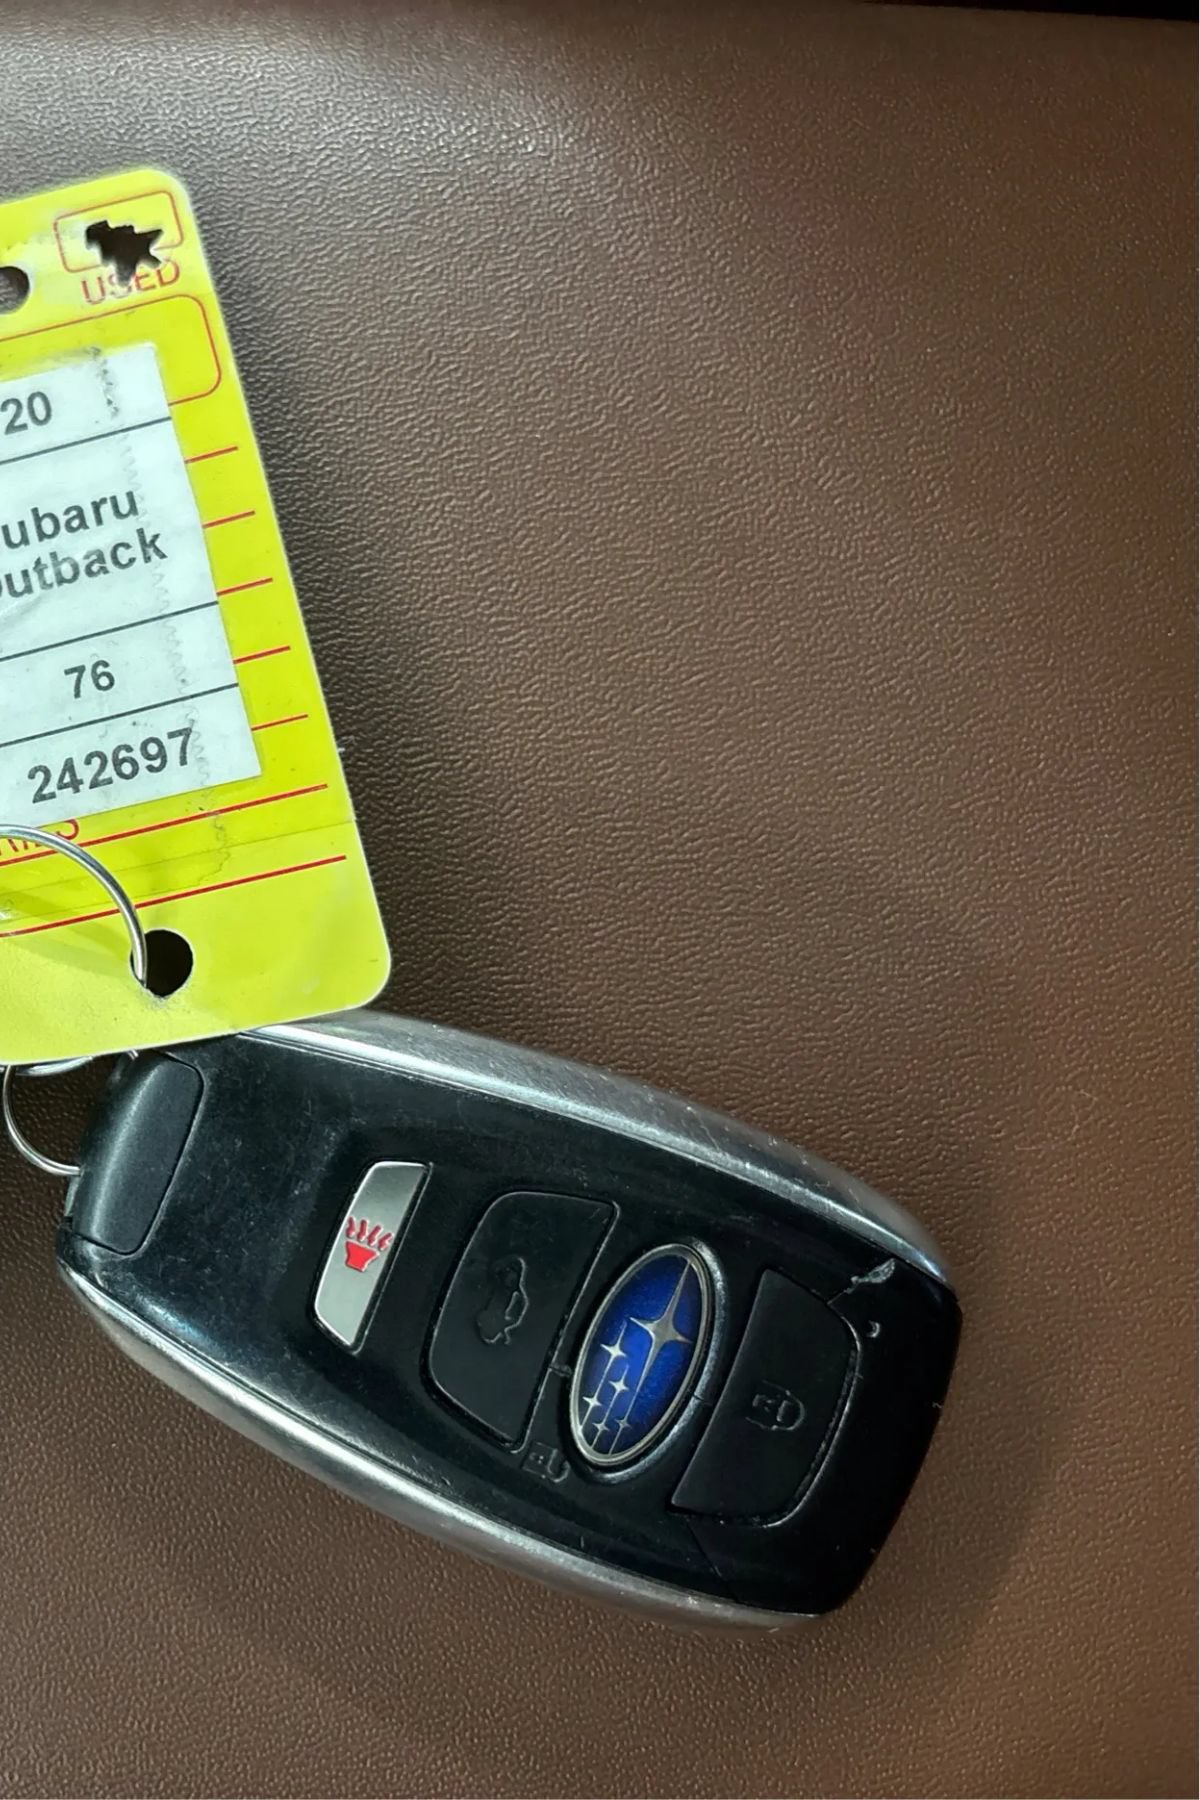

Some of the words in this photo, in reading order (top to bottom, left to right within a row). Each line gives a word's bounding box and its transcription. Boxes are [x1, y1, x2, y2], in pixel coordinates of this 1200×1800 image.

[0, 391, 52, 434] 20
[64, 660, 115, 699] 76
[27, 728, 194, 803] 242697
